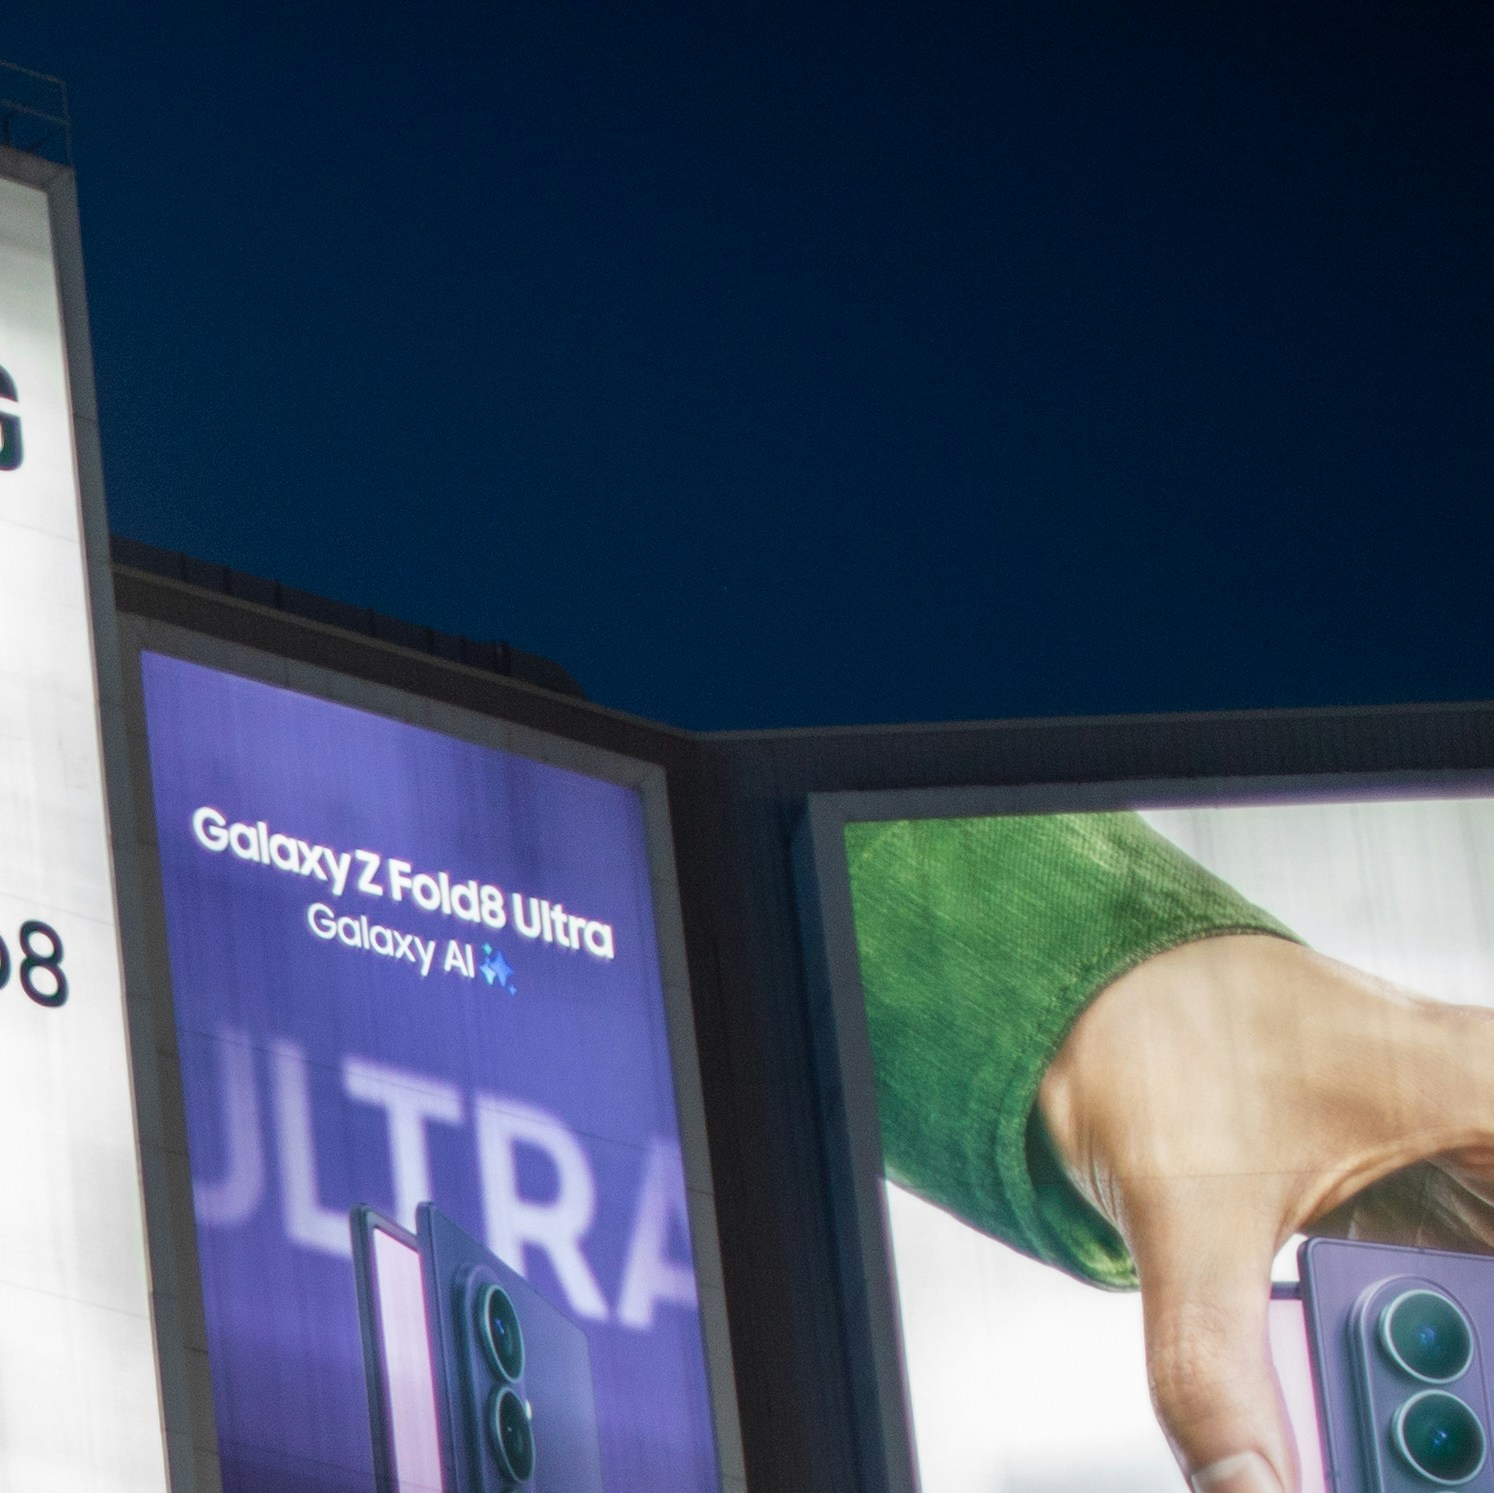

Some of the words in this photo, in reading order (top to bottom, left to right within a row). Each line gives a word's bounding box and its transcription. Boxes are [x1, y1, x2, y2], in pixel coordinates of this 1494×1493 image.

[192, 806, 351, 898] Galaxy
[354, 848, 384, 897] Z
[388, 858, 507, 929] Fold8
[511, 893, 616, 960] Ultra
[306, 902, 435, 977] Galaxy
[443, 938, 477, 980] AI
